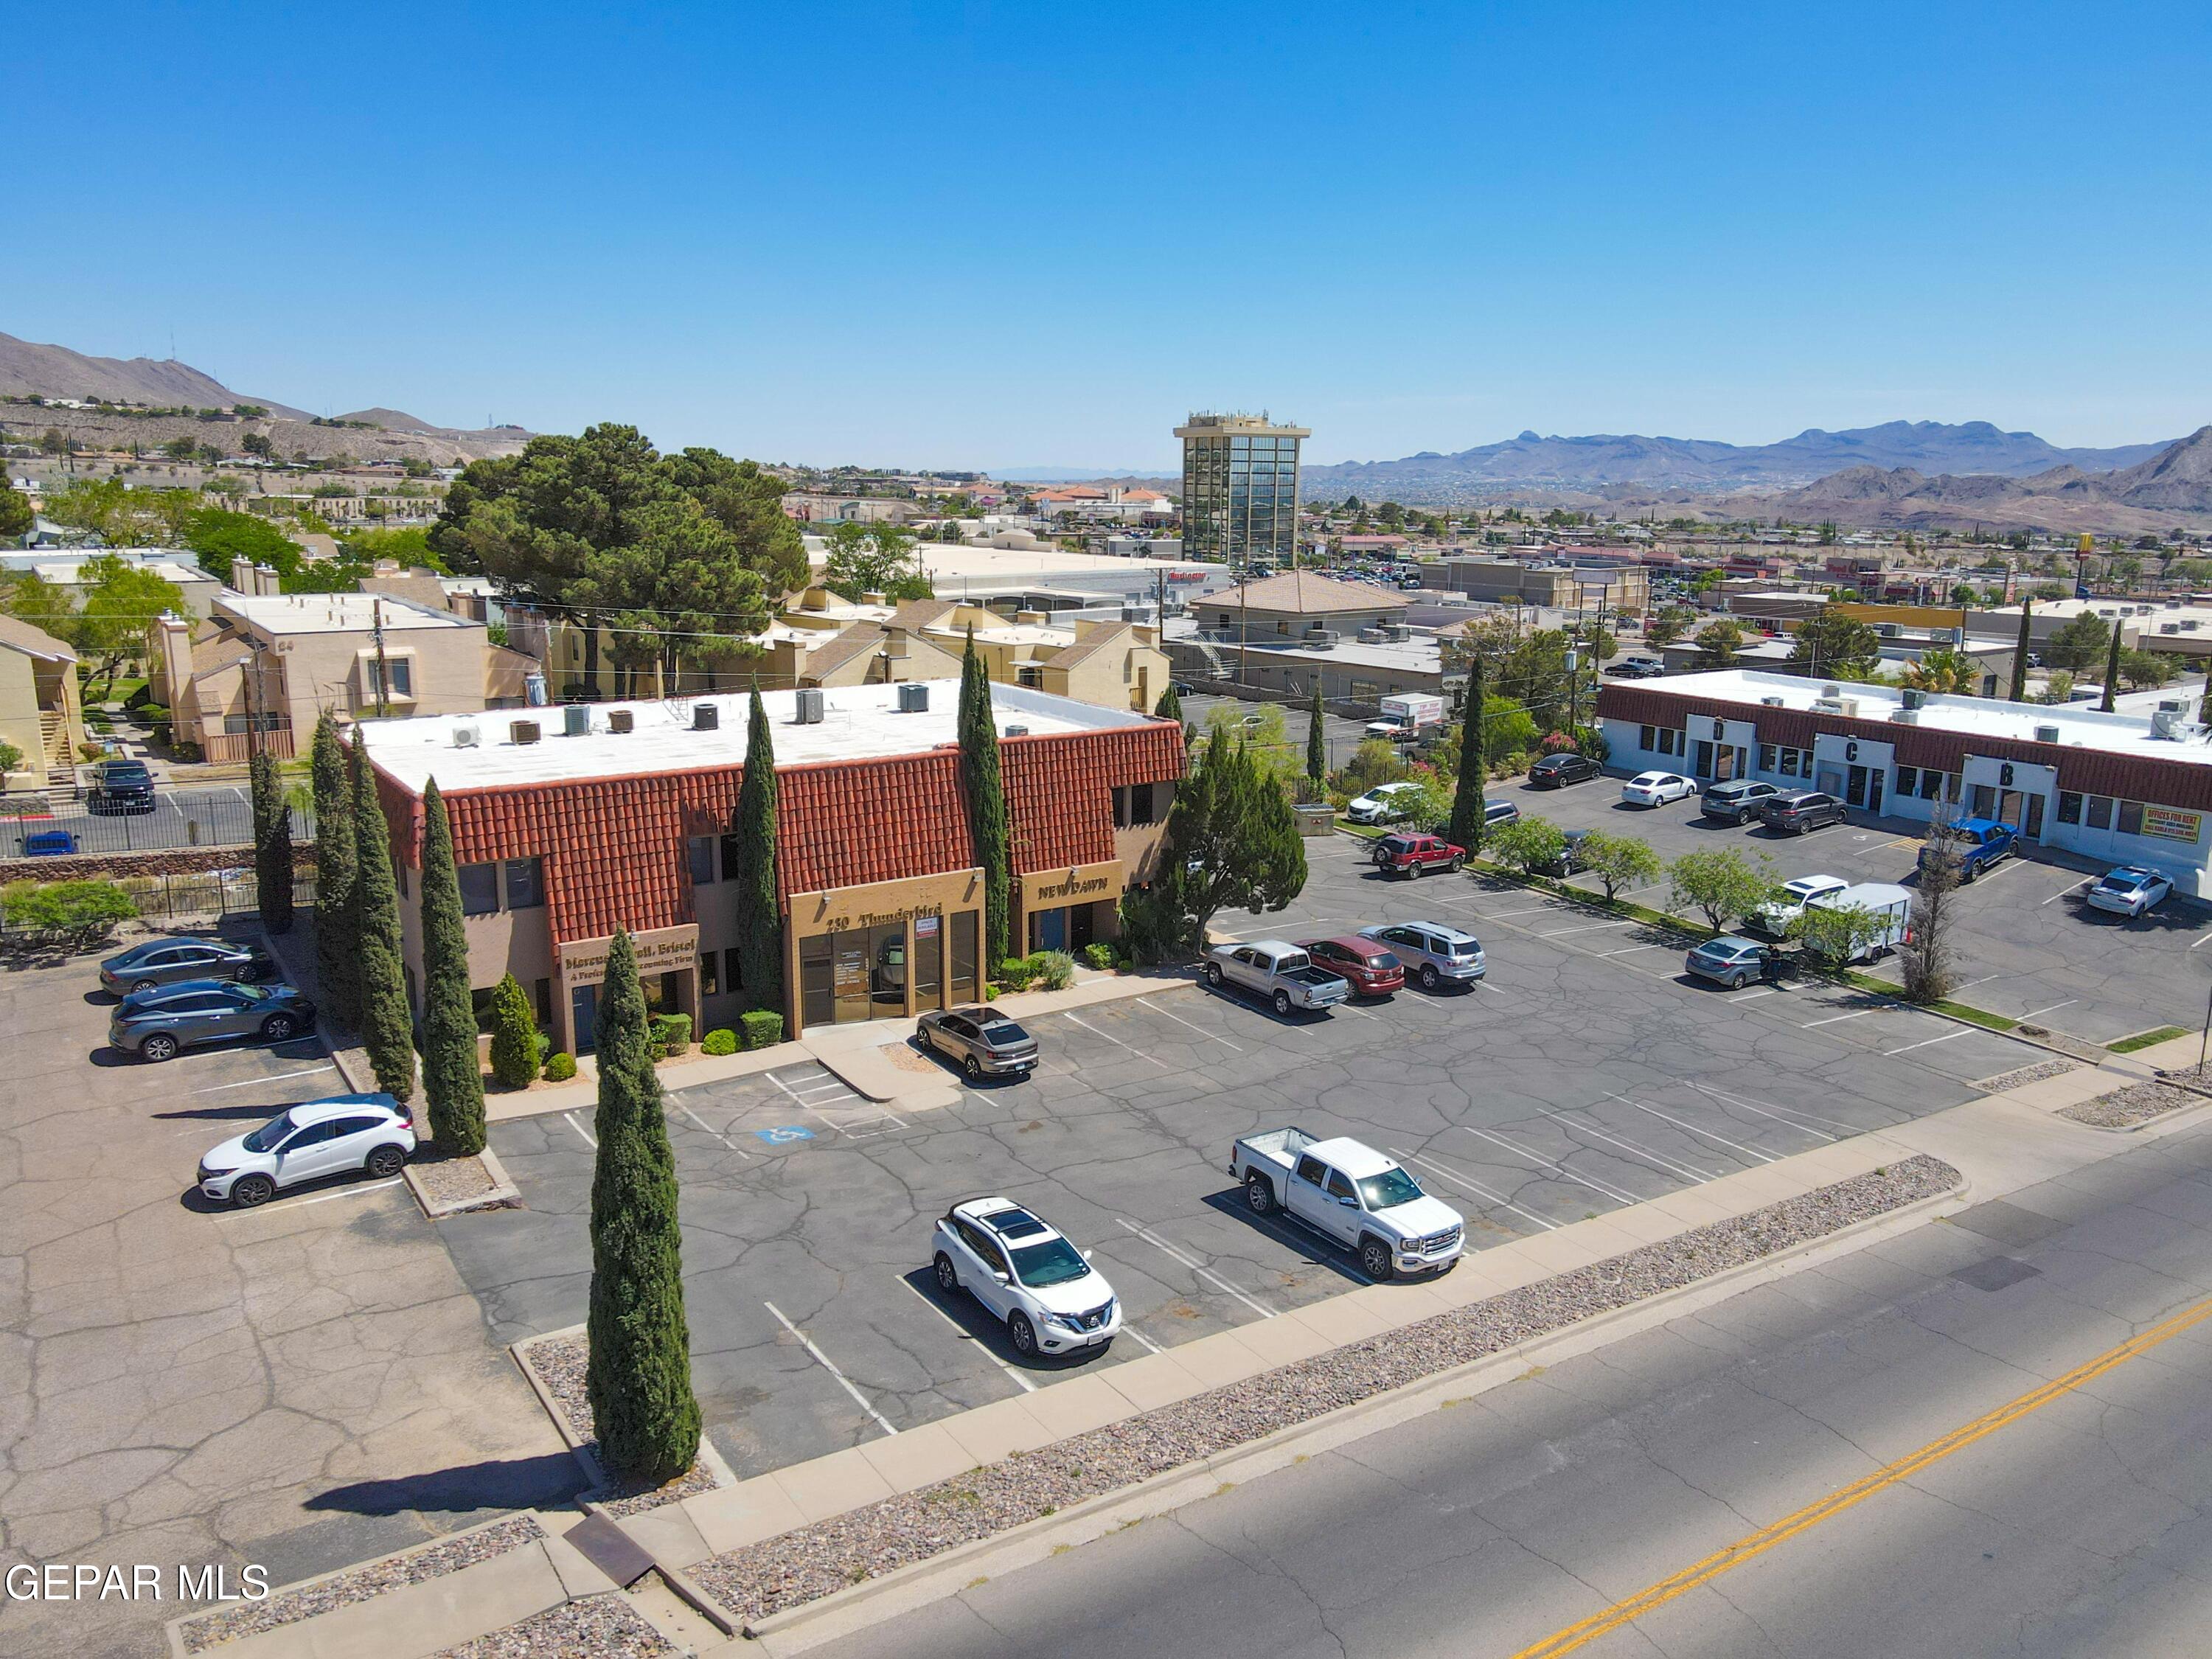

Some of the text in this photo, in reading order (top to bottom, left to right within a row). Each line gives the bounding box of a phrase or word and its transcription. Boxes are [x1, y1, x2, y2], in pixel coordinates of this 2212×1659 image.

[1713, 722, 1724, 741] D
[1846, 742, 1858, 762] C
[2000, 764, 2014, 787] B
[2147, 809, 2197, 825] OFFICES FOR RENT
[1038, 877, 1108, 900] NEW DAWN
[859, 902, 942, 925] Thunderbird
